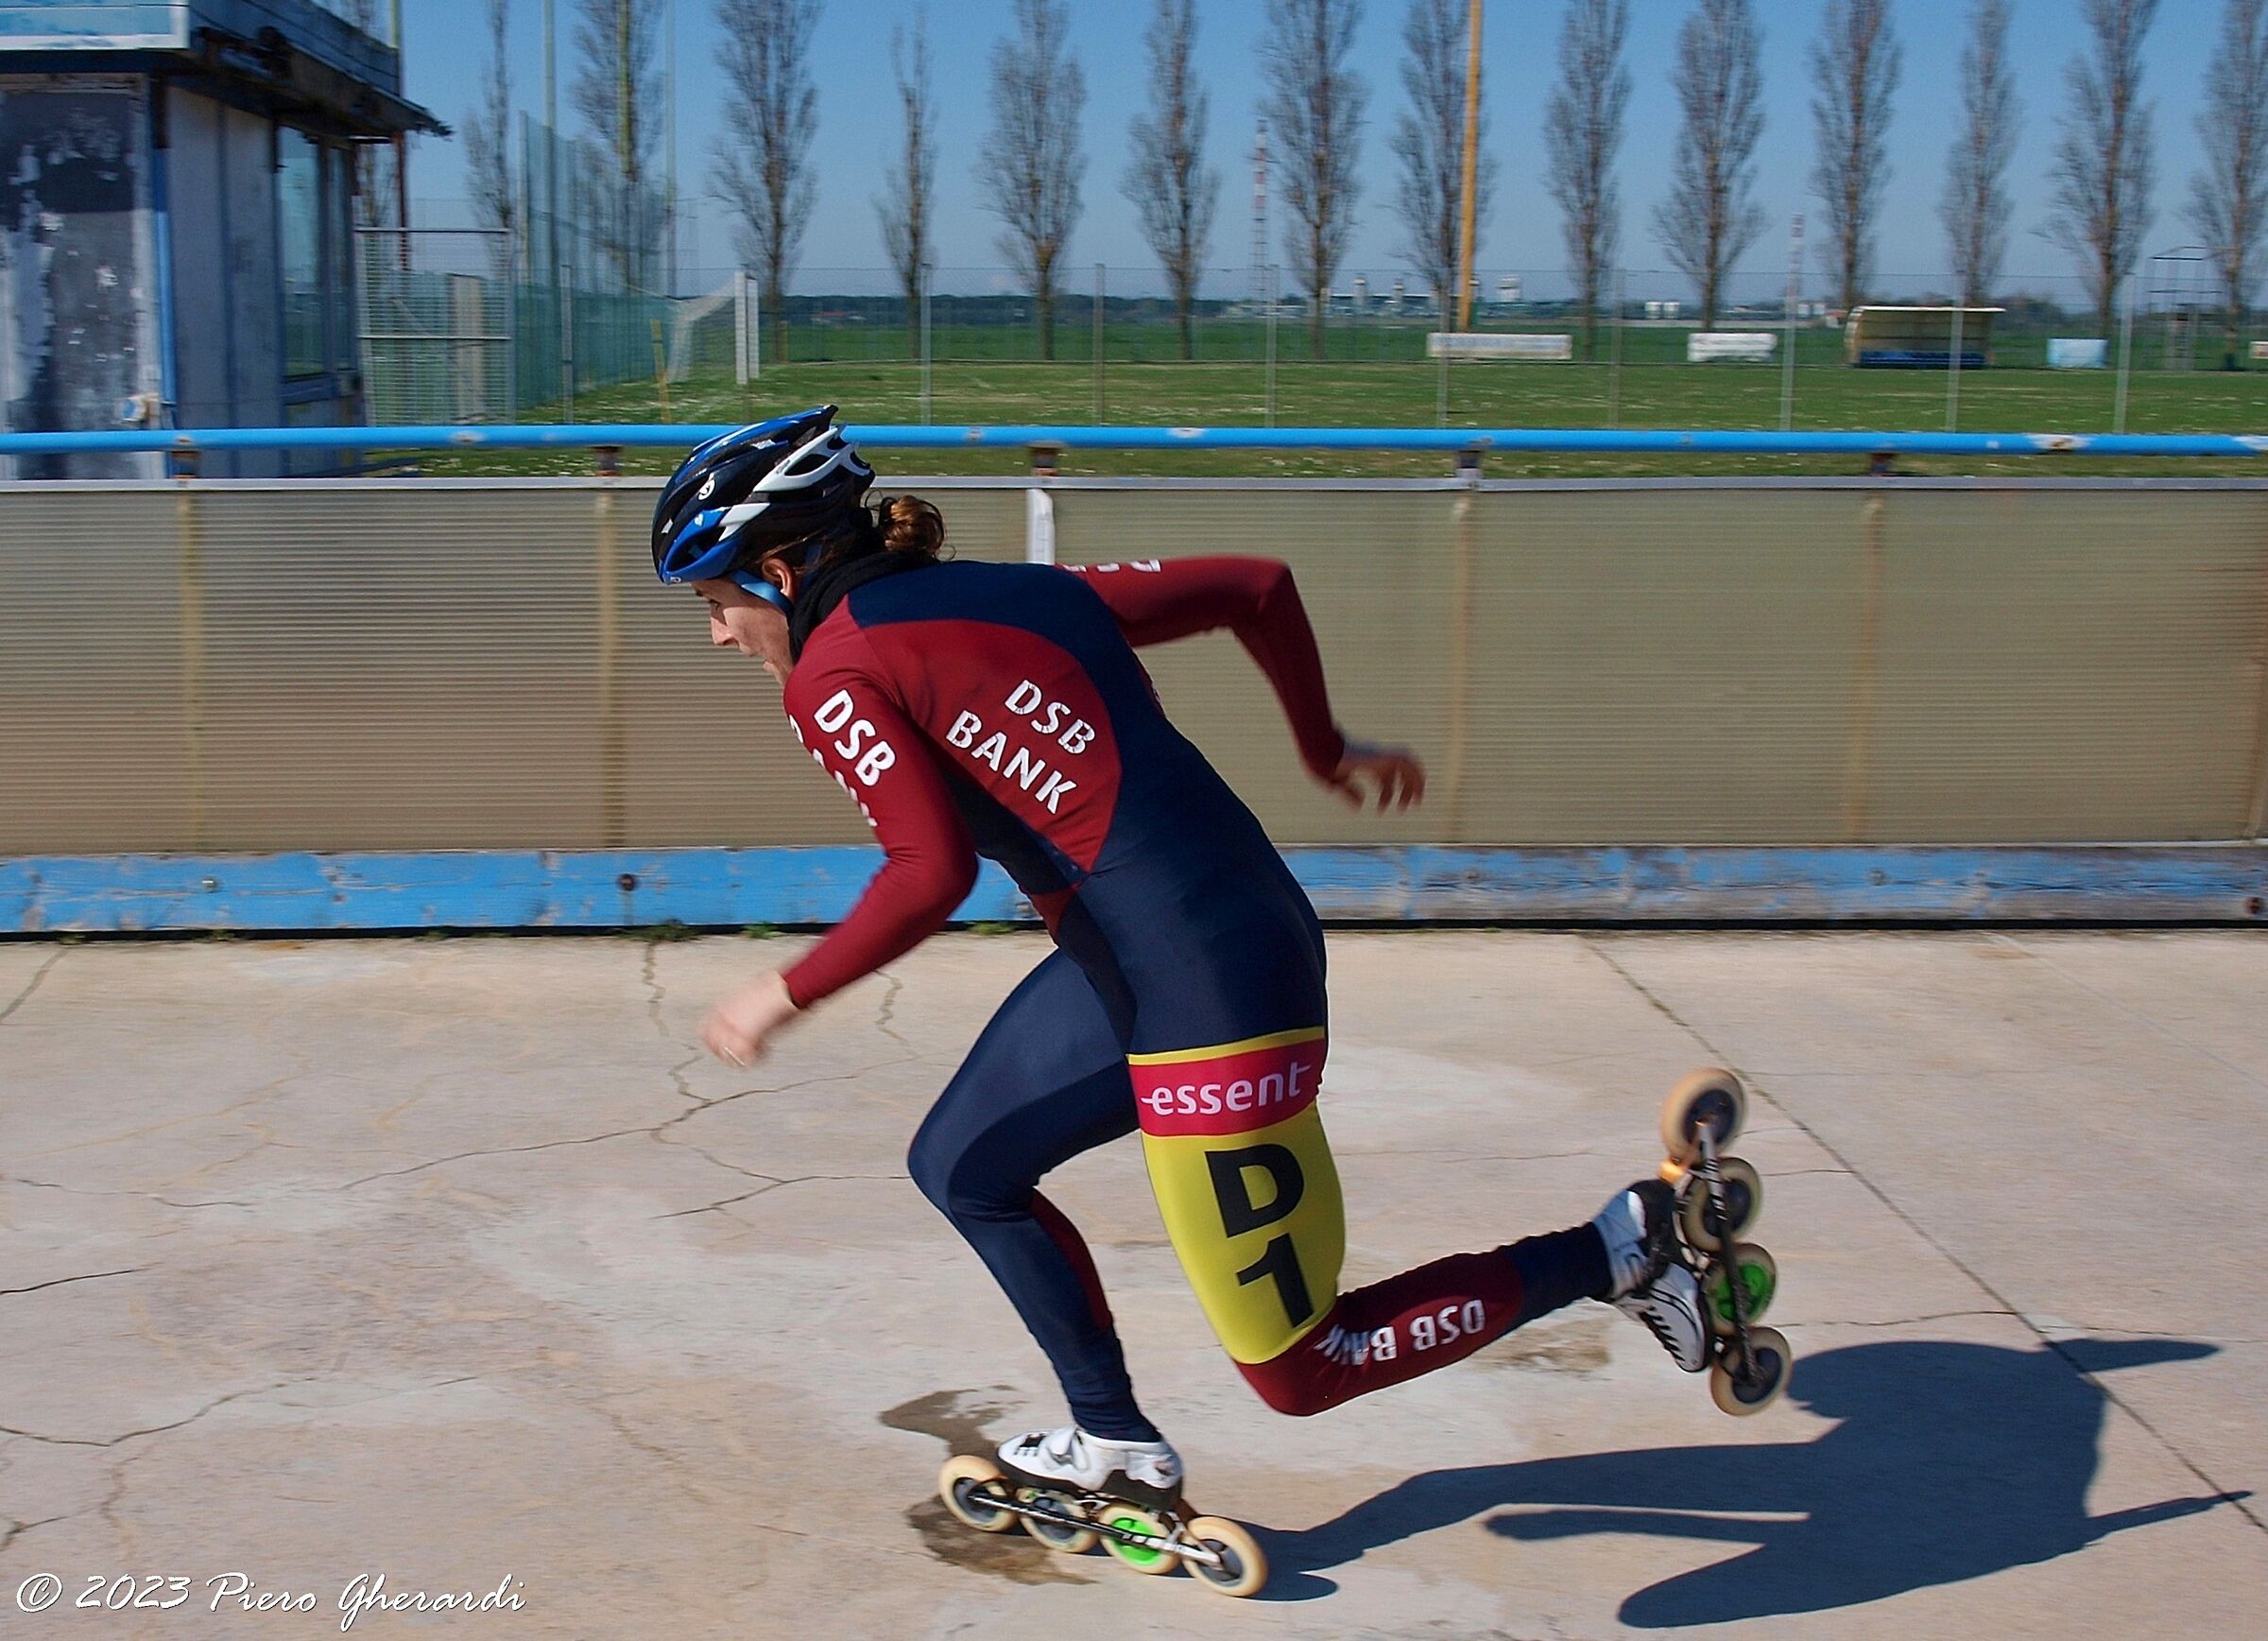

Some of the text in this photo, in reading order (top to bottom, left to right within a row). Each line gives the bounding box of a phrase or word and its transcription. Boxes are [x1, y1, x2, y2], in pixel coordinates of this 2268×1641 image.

[813, 688, 897, 786] DSB
[945, 709, 1078, 815] BANK
[1004, 679, 1096, 754] DSB
[1140, 1061, 1312, 1116] essent
[1204, 1143, 1305, 1239] D
[1235, 1232, 1315, 1328] 1
[1409, 1299, 1486, 1352] DSB
